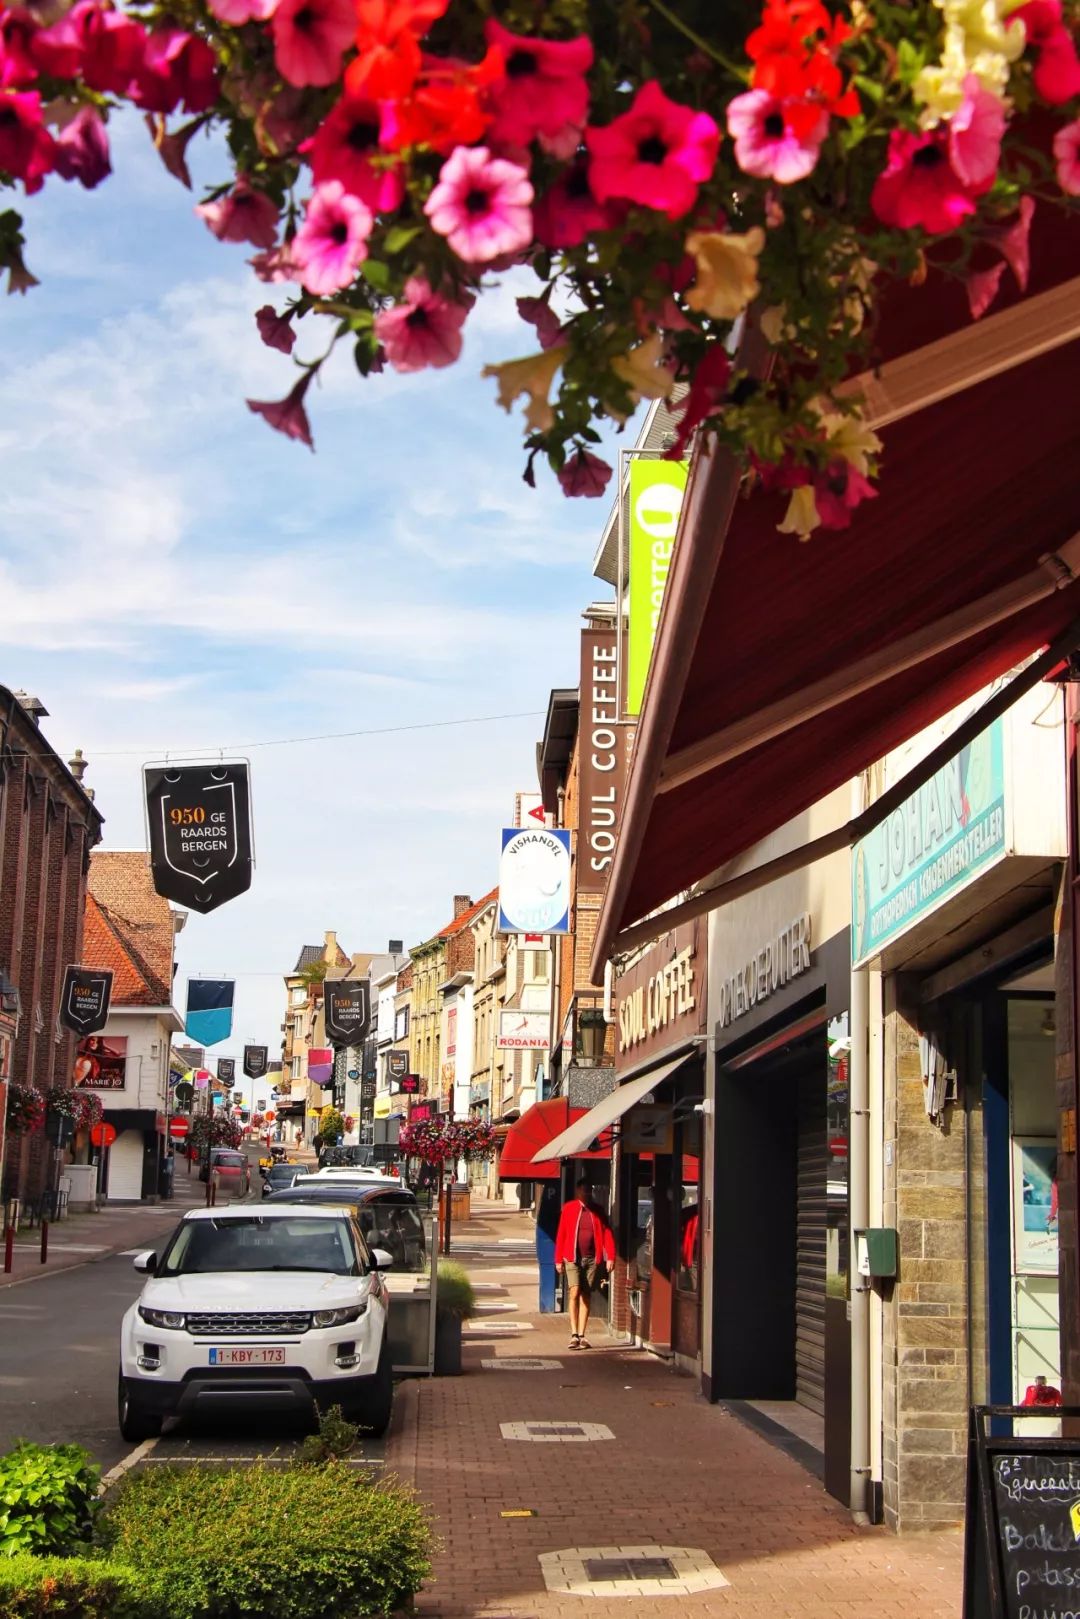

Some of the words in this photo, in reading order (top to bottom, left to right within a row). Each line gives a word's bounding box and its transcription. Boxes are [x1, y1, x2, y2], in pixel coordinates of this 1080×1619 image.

[592, 645, 617, 771] COFFEE
[170, 807, 205, 825] 950
[210, 812, 226, 823] GE
[181, 826, 227, 838] RAARDS
[591, 786, 615, 871] SOUL
[182, 840, 227, 852] BERGEN
[509, 835, 562, 857] VISHANDEL
[619, 986, 646, 1053] SOUL
[647, 945, 696, 1036] COFFEE
[500, 1038, 549, 1047] RODANIA
[218, 1350, 282, 1362] 1-KBY-173
